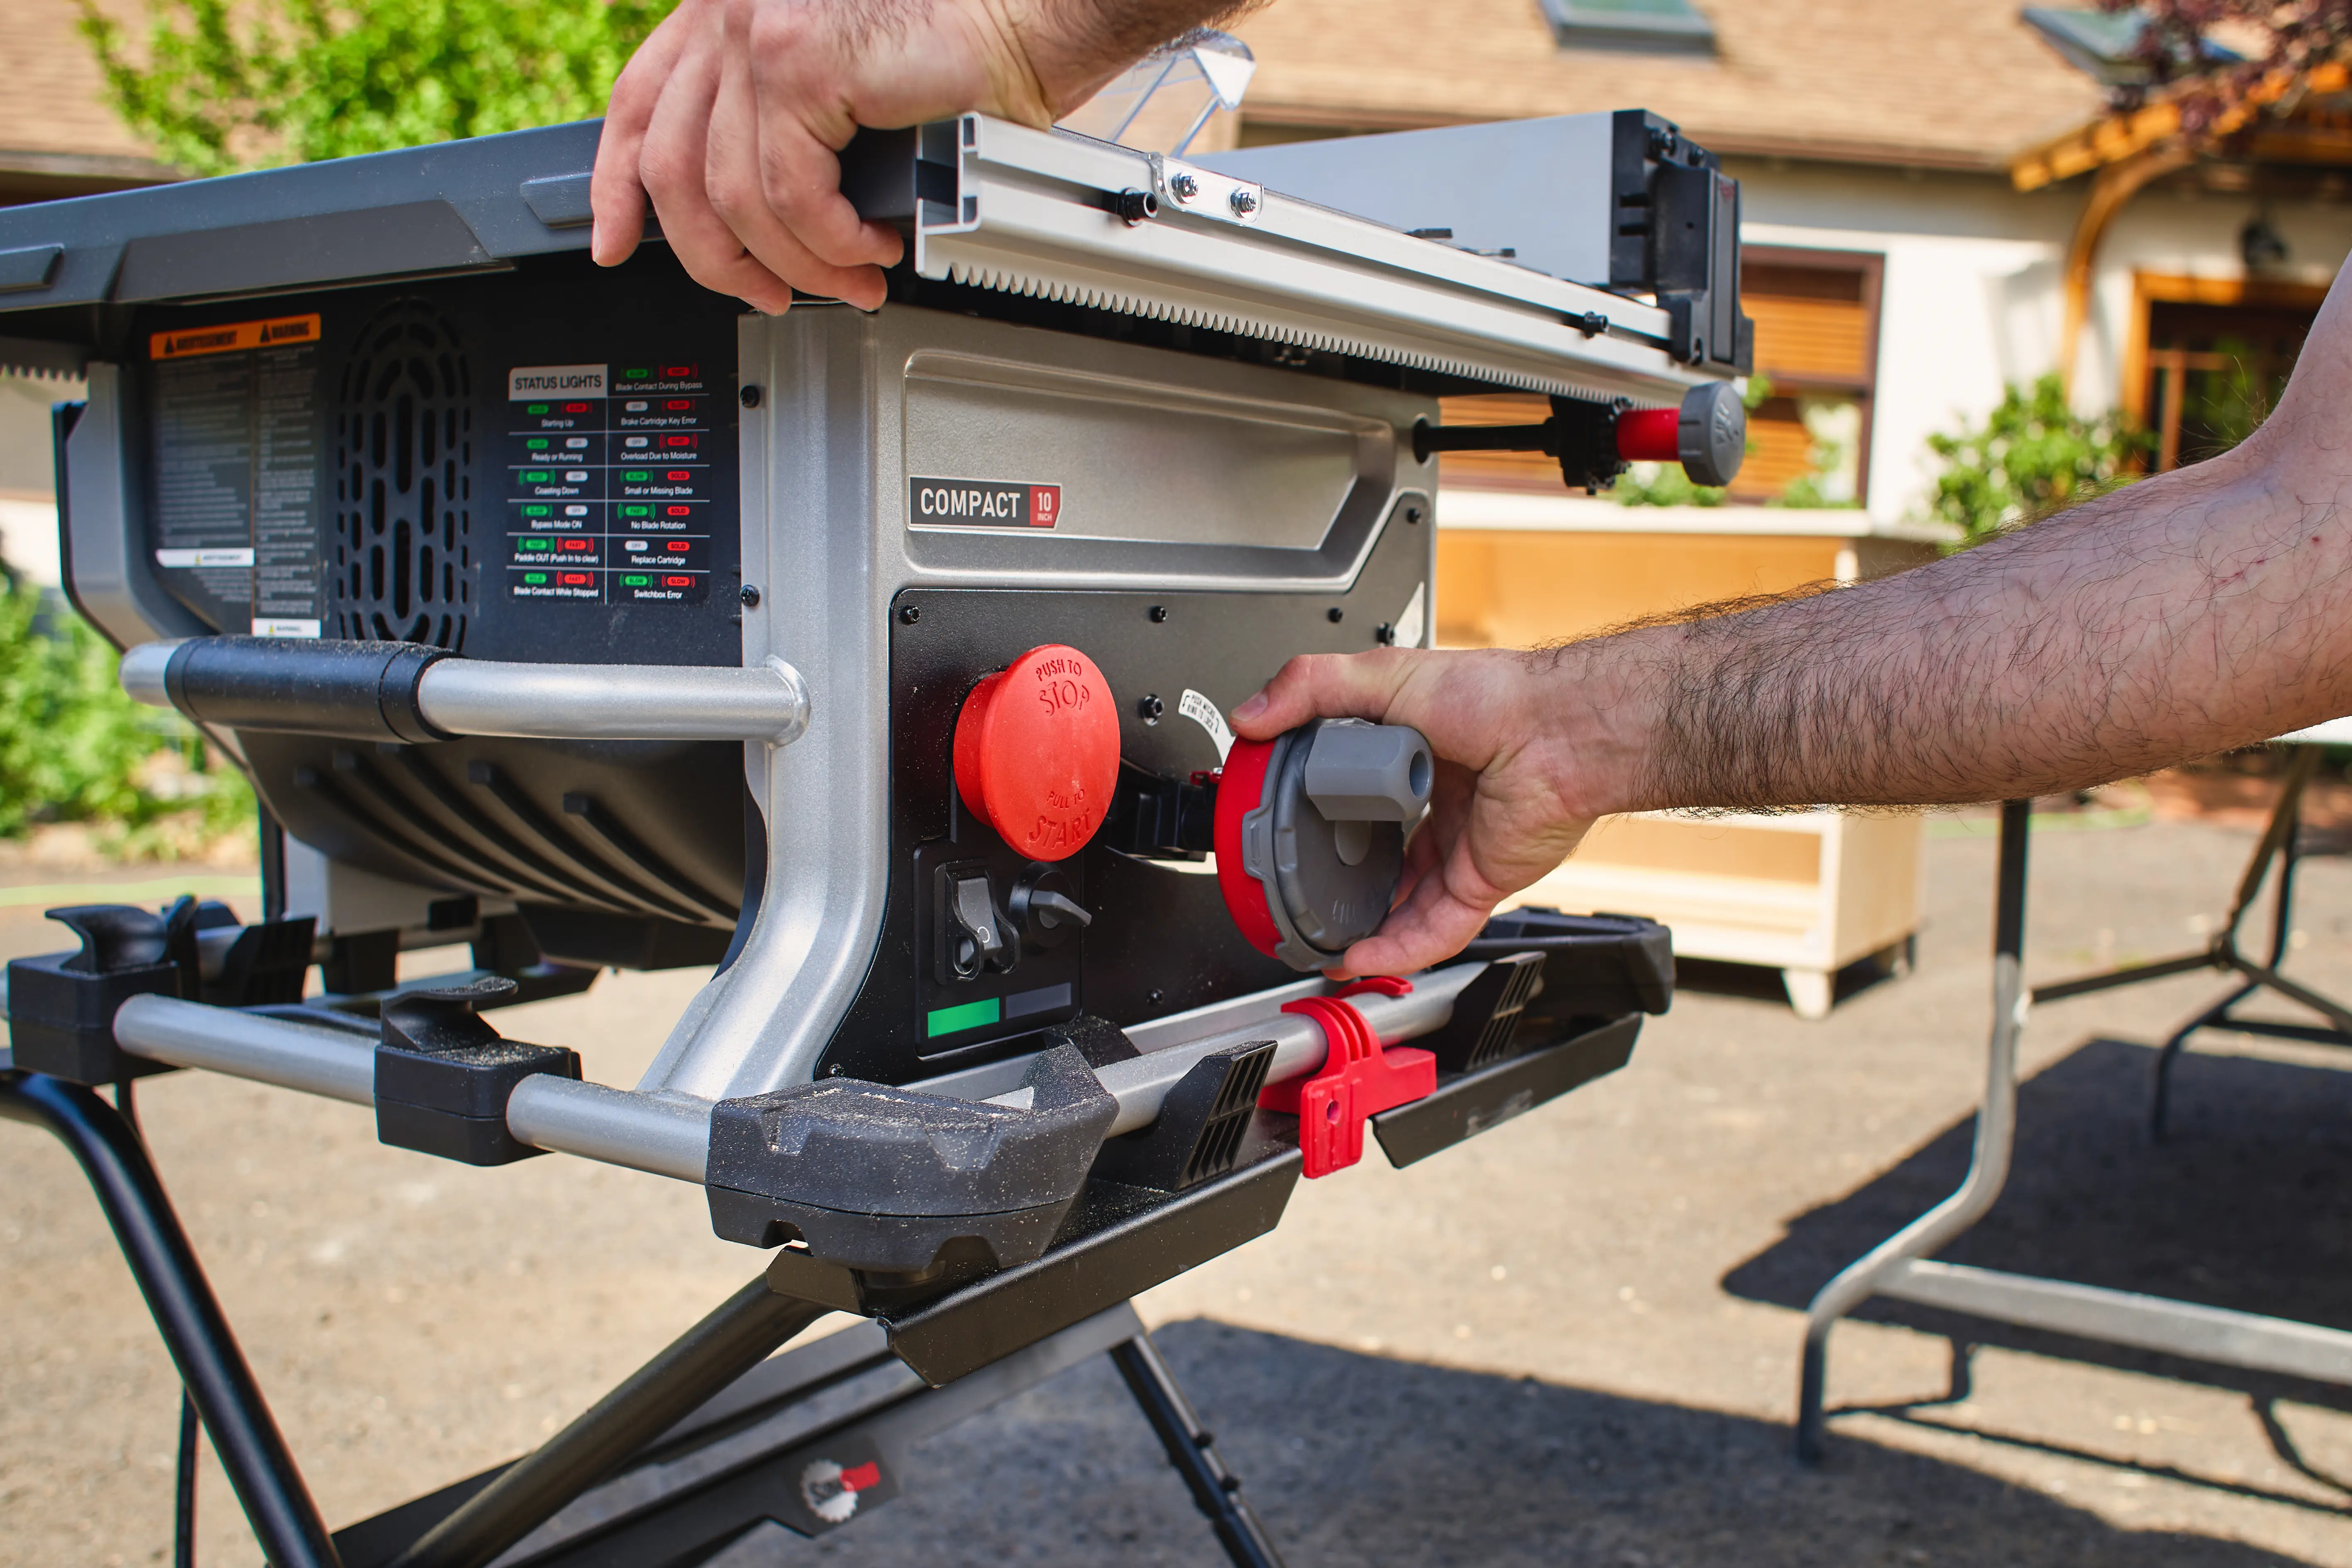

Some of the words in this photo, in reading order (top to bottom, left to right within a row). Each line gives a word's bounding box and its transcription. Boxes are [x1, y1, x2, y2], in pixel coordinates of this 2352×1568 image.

[515, 376, 557, 390] STATUS
[560, 375, 601, 388] LIGHTS
[659, 382, 679, 391] During
[680, 381, 702, 390] Bypass
[541, 419, 562, 428] Starting
[564, 419, 574, 427] Up
[621, 417, 639, 426] Brake
[640, 417, 667, 426] Cartridge
[669, 417, 680, 426] Key
[682, 416, 697, 424] Error
[532, 453, 550, 463] Ready
[559, 453, 583, 462] Running
[621, 452, 648, 460] Overload
[649, 452, 662, 460] Due
[670, 452, 697, 460] Moisture
[535, 486, 561, 497] Coasting
[562, 487, 579, 495] Down
[625, 487, 642, 495] Small
[650, 487, 674, 496] Missing
[675, 487, 693, 495] Blade
[920, 487, 1020, 518] COMPACT
[1038, 492, 1052, 511] 10
[1037, 513, 1052, 521] INCH
[531, 520, 553, 530] Bypass
[554, 520, 571, 529] Mode
[572, 520, 582, 529] ON
[631, 521, 641, 529] No
[641, 521, 659, 529] Blade
[660, 521, 686, 530] Rotation
[514, 553, 535, 562] Paddle
[536, 553, 550, 562] OUT
[550, 553, 567, 564] (Push
[575, 555, 582, 563] to
[582, 555, 599, 564] clear)
[631, 555, 656, 565] Replace
[657, 556, 686, 566] Cartridge
[514, 586, 531, 596] Blade
[531, 586, 555, 596] Contact
[555, 587, 572, 597] While
[573, 588, 599, 598] Stopped
[634, 589, 666, 598] Switchbox
[667, 591, 682, 599] Error
[1036, 660, 1065, 682] PUSH
[1067, 659, 1081, 676] TO
[1039, 680, 1090, 717] STOP
[1191, 694, 1202, 705] PUSH
[1203, 703, 1216, 719] MICRO
[1187, 704, 1198, 715] RING
[1198, 709, 1204, 719] TO
[1204, 717, 1214, 730] LOCK
[1047, 790, 1069, 809] PULL
[1074, 789, 1085, 805] TO
[1028, 807, 1090, 849] START
